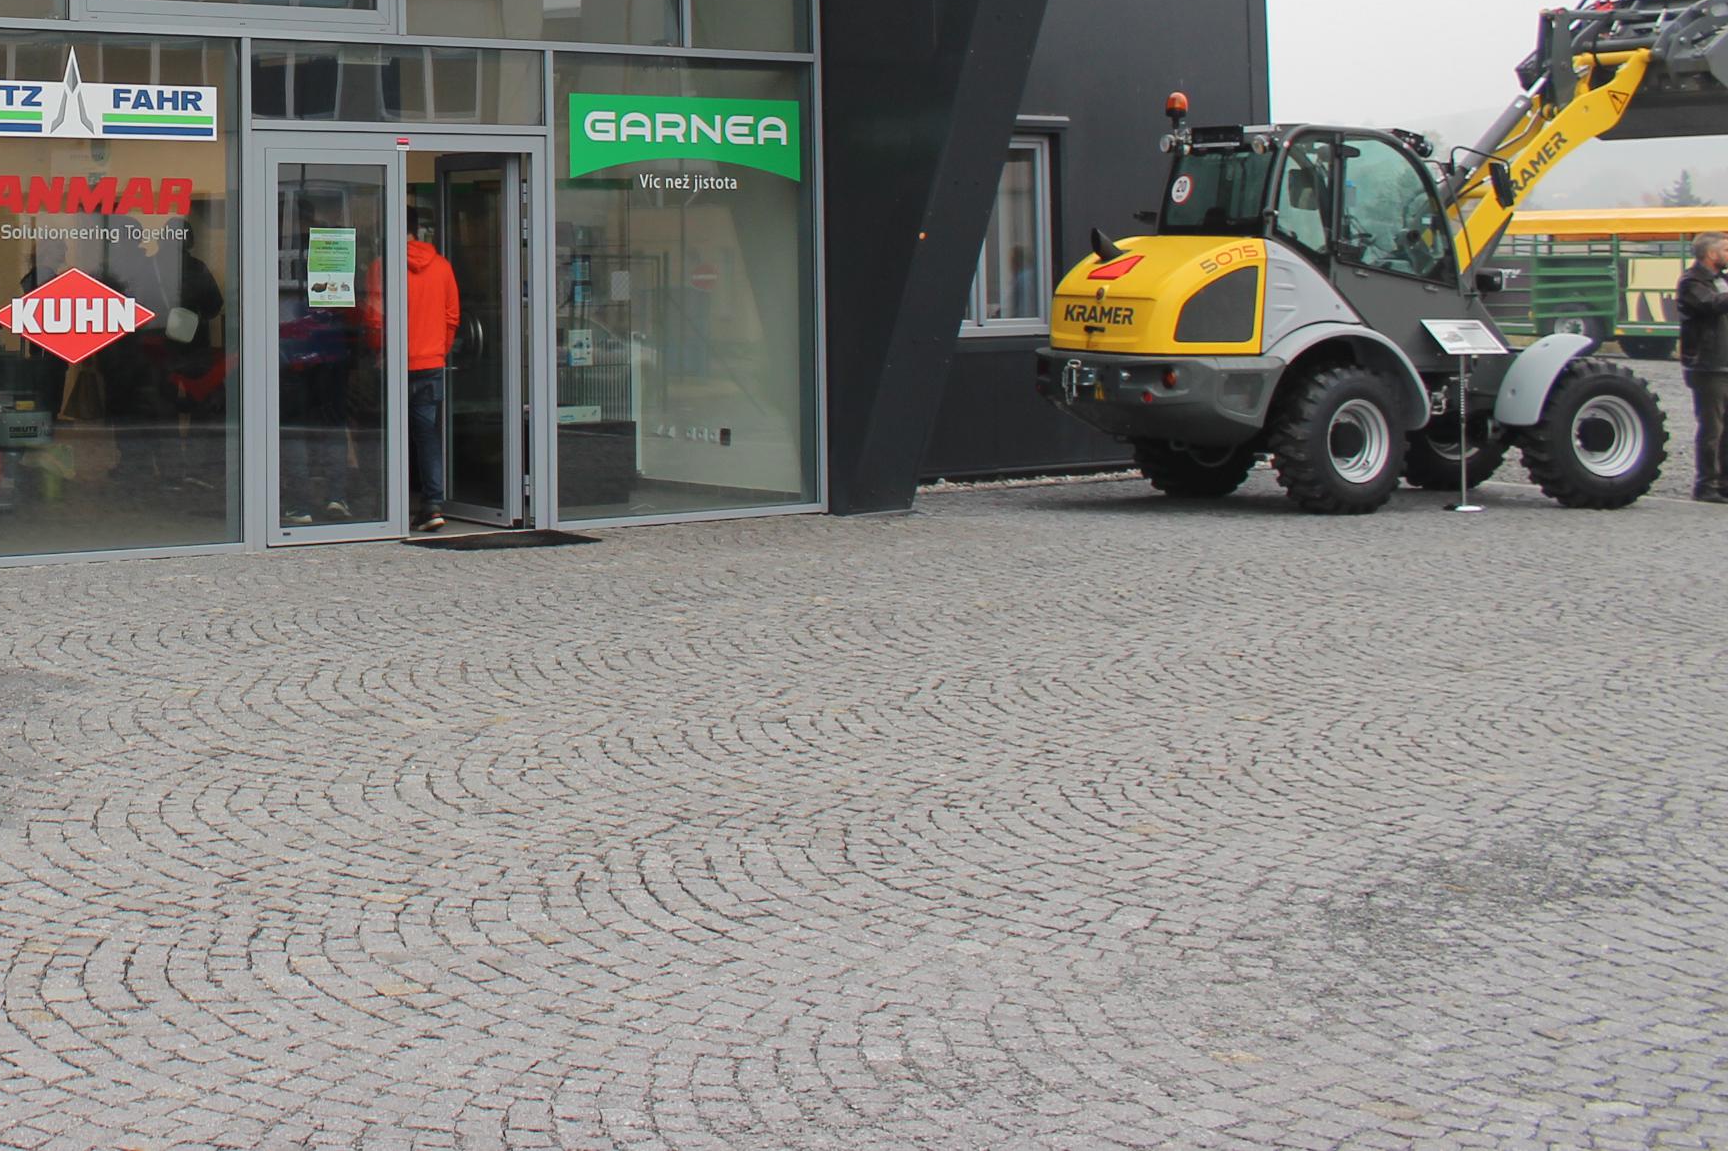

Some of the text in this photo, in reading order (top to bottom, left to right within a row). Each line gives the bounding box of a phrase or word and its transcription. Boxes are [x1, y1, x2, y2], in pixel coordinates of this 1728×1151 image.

[112, 88, 202, 111] FAHR
[584, 110, 788, 146] GARNEA
[1509, 131, 1568, 198] RAMER
[639, 173, 737, 192] Víc než jistota
[0, 224, 189, 243] Solutioneering Together
[1199, 244, 1258, 274] 5075
[11, 298, 135, 333] KUHN
[1064, 304, 1134, 325] KRAMER
